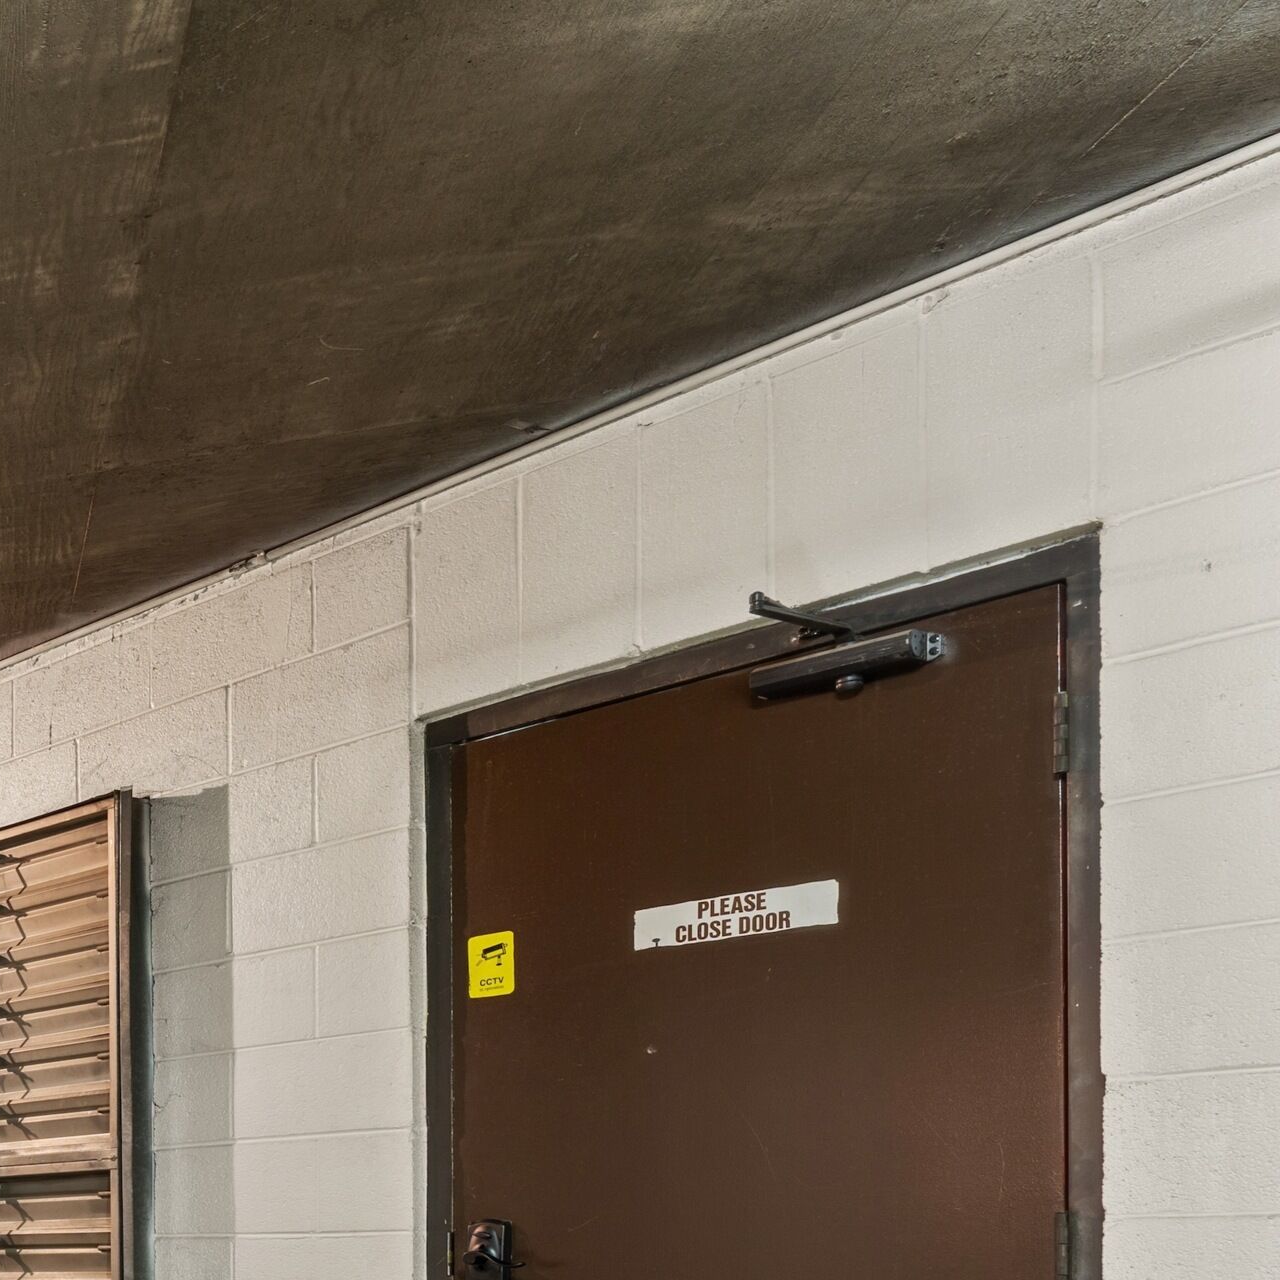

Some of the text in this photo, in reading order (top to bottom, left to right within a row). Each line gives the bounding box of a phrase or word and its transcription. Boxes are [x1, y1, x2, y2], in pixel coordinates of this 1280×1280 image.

[697, 892, 767, 919] PLEASE
[675, 910, 791, 943] CLOSE DOOR
[479, 976, 504, 987] CCTV
